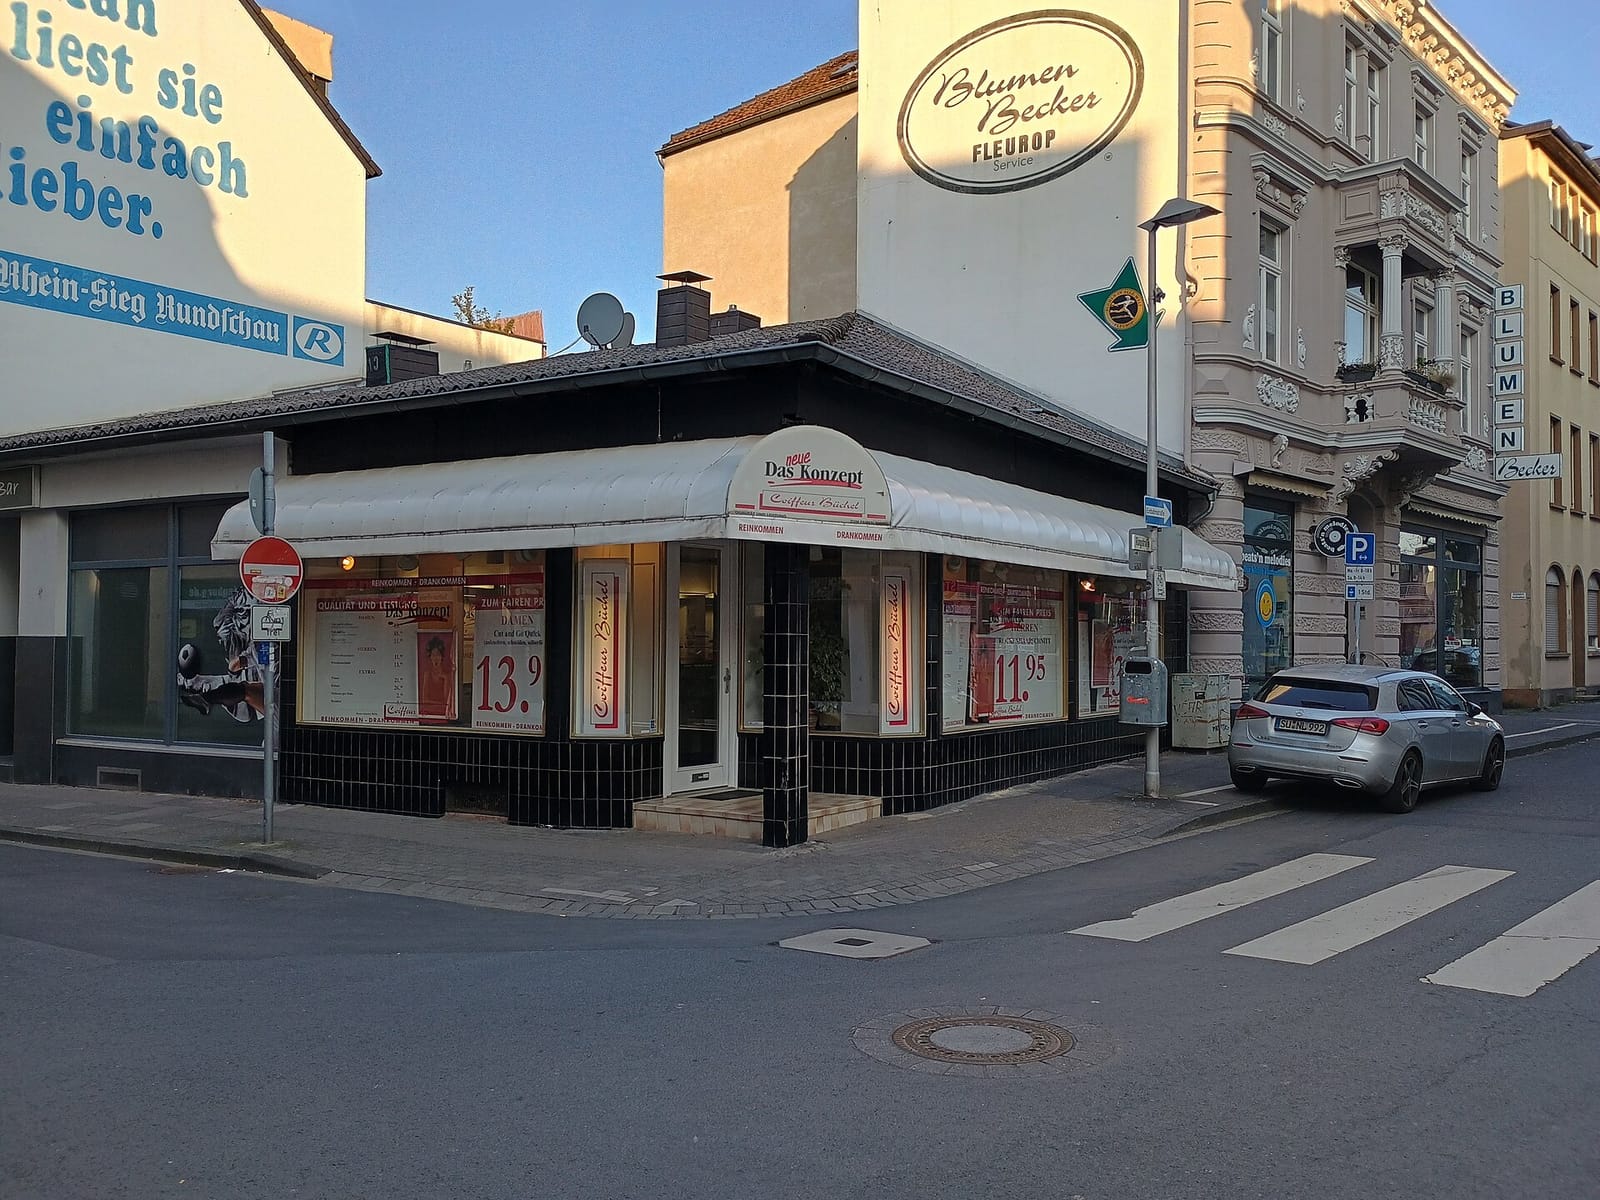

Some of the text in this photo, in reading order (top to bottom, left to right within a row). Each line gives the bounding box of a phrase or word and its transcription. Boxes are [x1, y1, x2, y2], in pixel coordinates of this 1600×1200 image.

[67, 0, 158, 37] an
[9, 2, 223, 124] liest sie
[933, 63, 1079, 108] Blumen
[977, 85, 1102, 135] Becker
[46, 95, 249, 198] einfach
[972, 129, 1056, 163] FLEUROP
[993, 156, 1033, 172] Service
[0, 146, 163, 239] ieber.
[1500, 289, 1517, 447] BLUMEN
[786, 452, 811, 467] neue
[1497, 457, 1557, 479] Becker
[765, 461, 863, 487] Das Konzept
[770, 493, 815, 507] Coiffeur
[738, 523, 883, 541] REINKOMMEN DRANKOMMEN
[1352, 537, 1368, 560] P
[1264, 553, 1291, 567] melodies
[371, 579, 412, 587] REINKOMMEN
[419, 577, 466, 586] DRANKOMMEN
[358, 601, 376, 610] UND
[481, 599, 499, 607] ZUM
[501, 615, 535, 625] DAMEN
[594, 580, 612, 718] Coiffeur Büchel
[888, 583, 902, 715] Coiffeur Büchel
[476, 721, 512, 729] REINKOMMEN
[1308, 723, 1325, 733] 992
